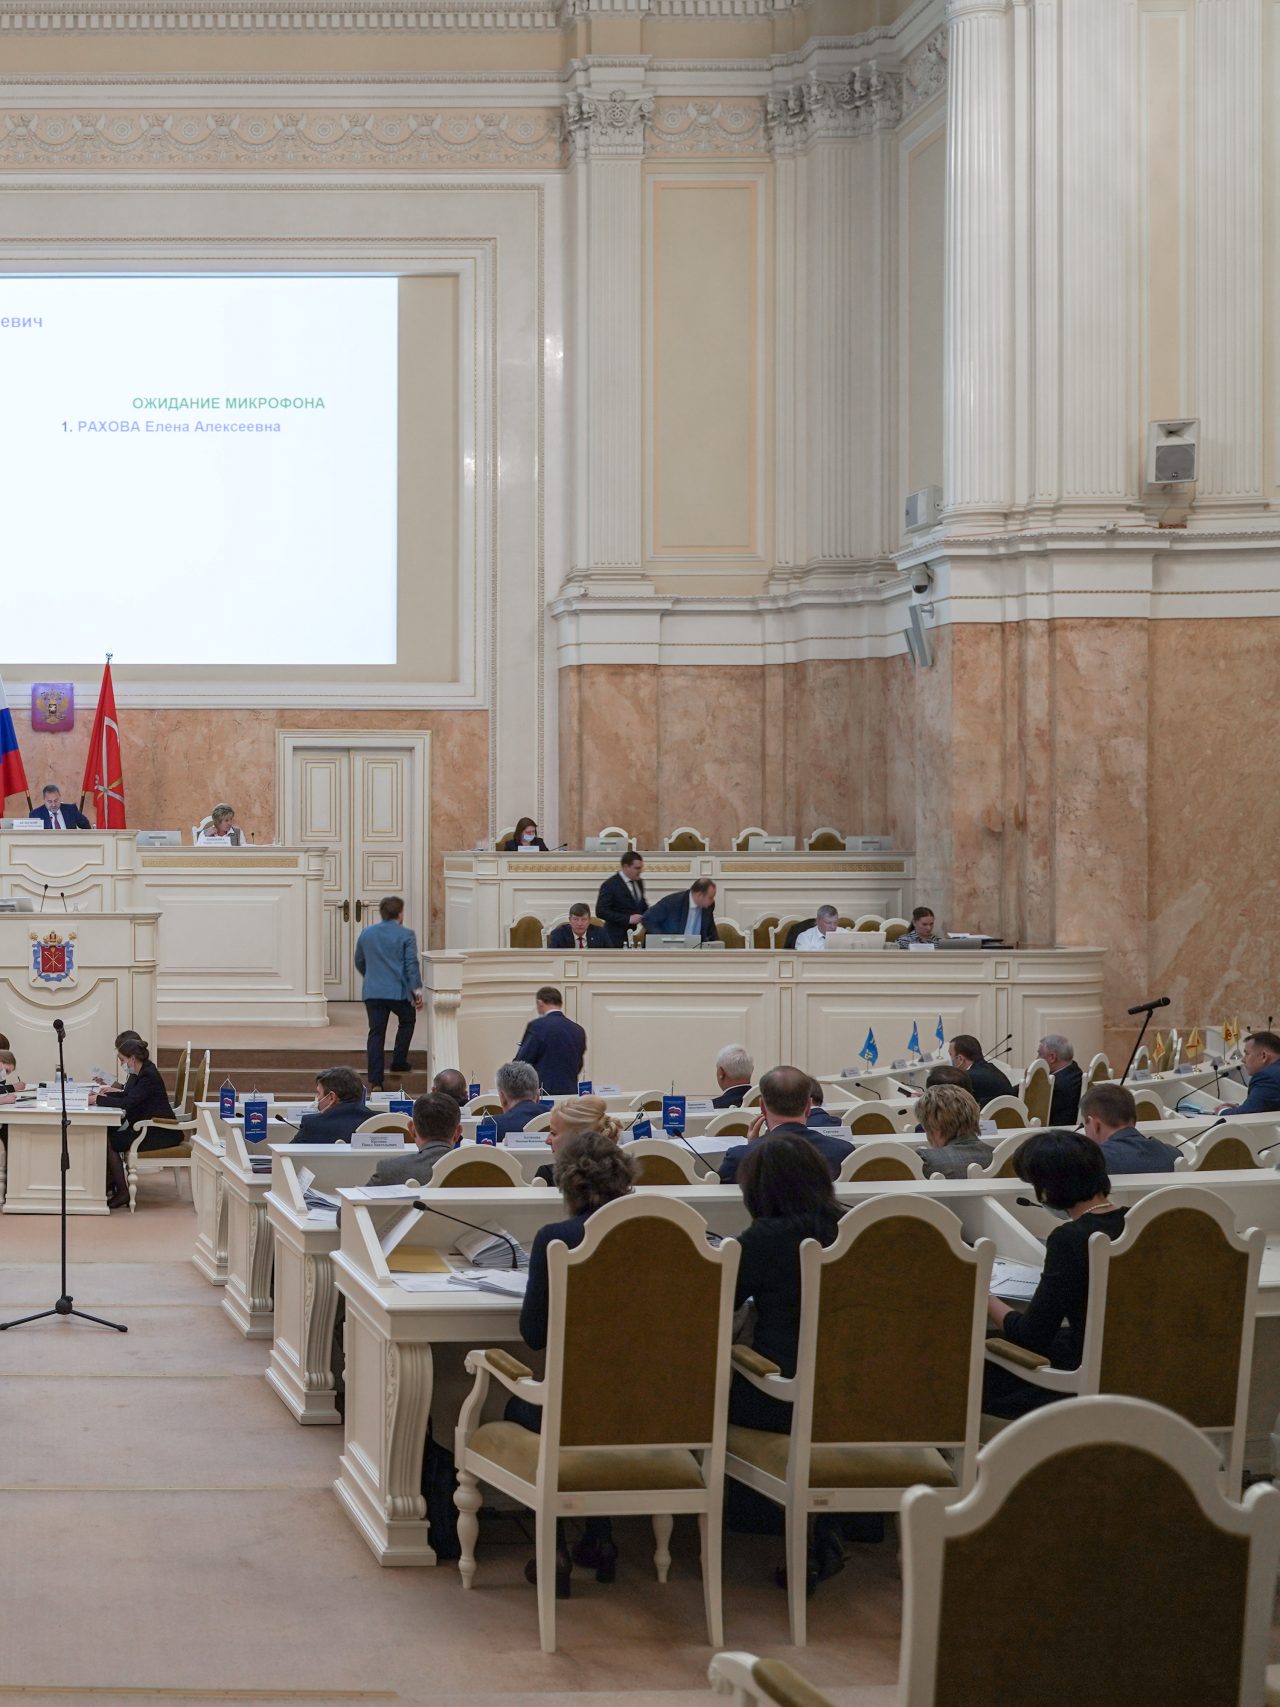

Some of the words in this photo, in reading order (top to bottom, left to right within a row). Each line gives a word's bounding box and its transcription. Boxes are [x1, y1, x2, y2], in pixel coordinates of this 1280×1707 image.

[131, 396, 221, 412] ОЖИДАНИЕ
[224, 396, 326, 410] МИКРОФОНА
[61, 420, 73, 433] 1.
[77, 420, 141, 433] РАХОВА
[145, 420, 190, 433] Елена
[193, 420, 281, 433] Алексеевна
